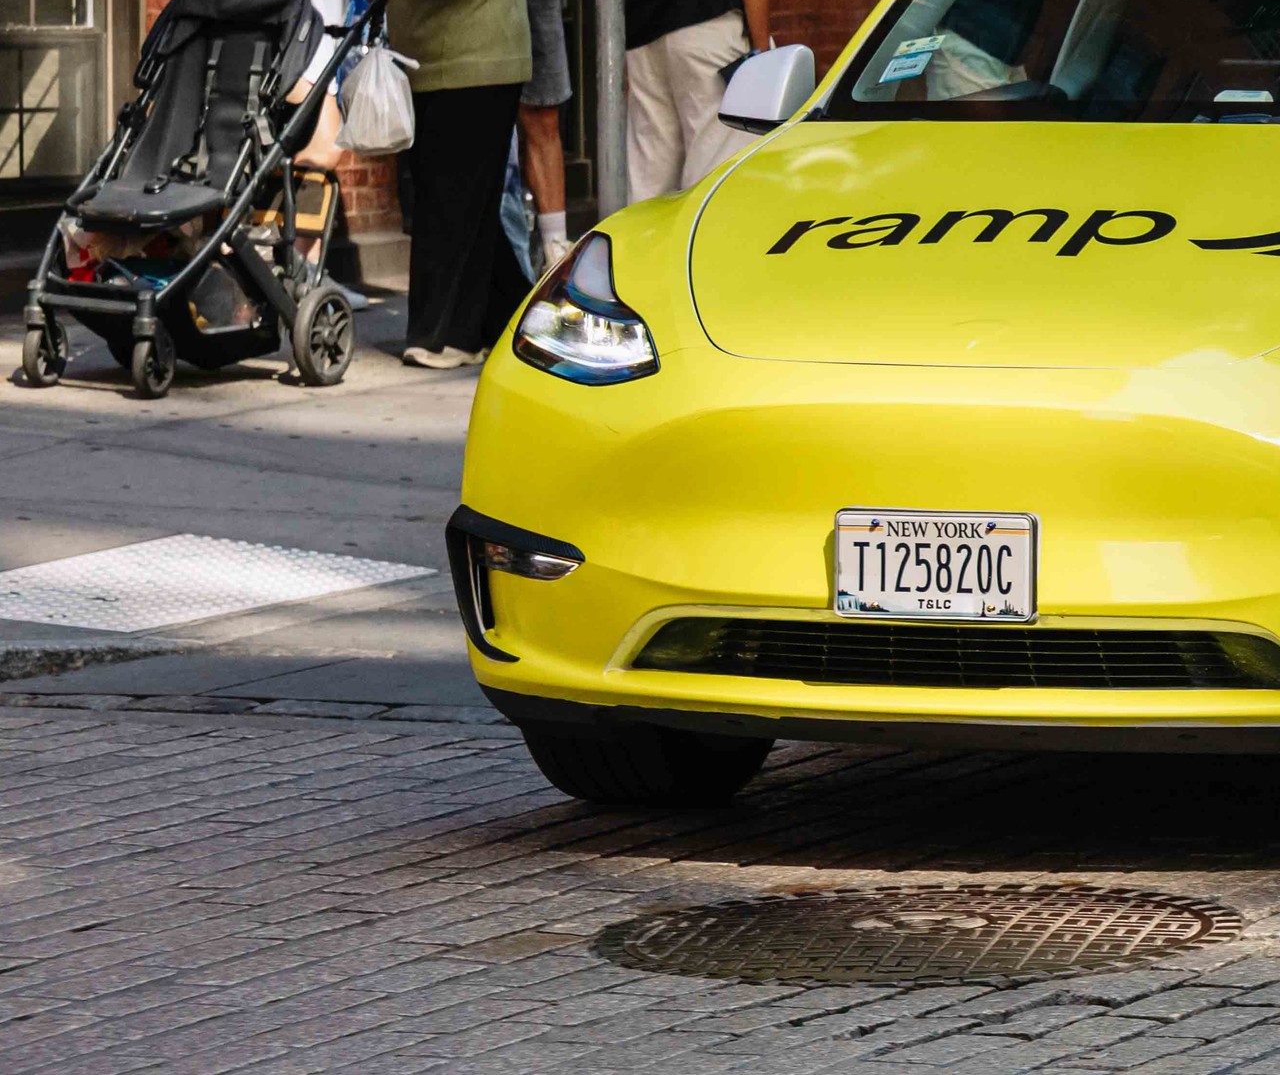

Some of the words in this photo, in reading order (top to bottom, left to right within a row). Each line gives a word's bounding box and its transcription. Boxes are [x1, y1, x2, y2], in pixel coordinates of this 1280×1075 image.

[765, 209, 1177, 257] ramp
[886, 521, 930, 538] NEW
[932, 522, 984, 539] YORK
[853, 541, 1013, 595] T125820C
[917, 599, 952, 610] T&LC
